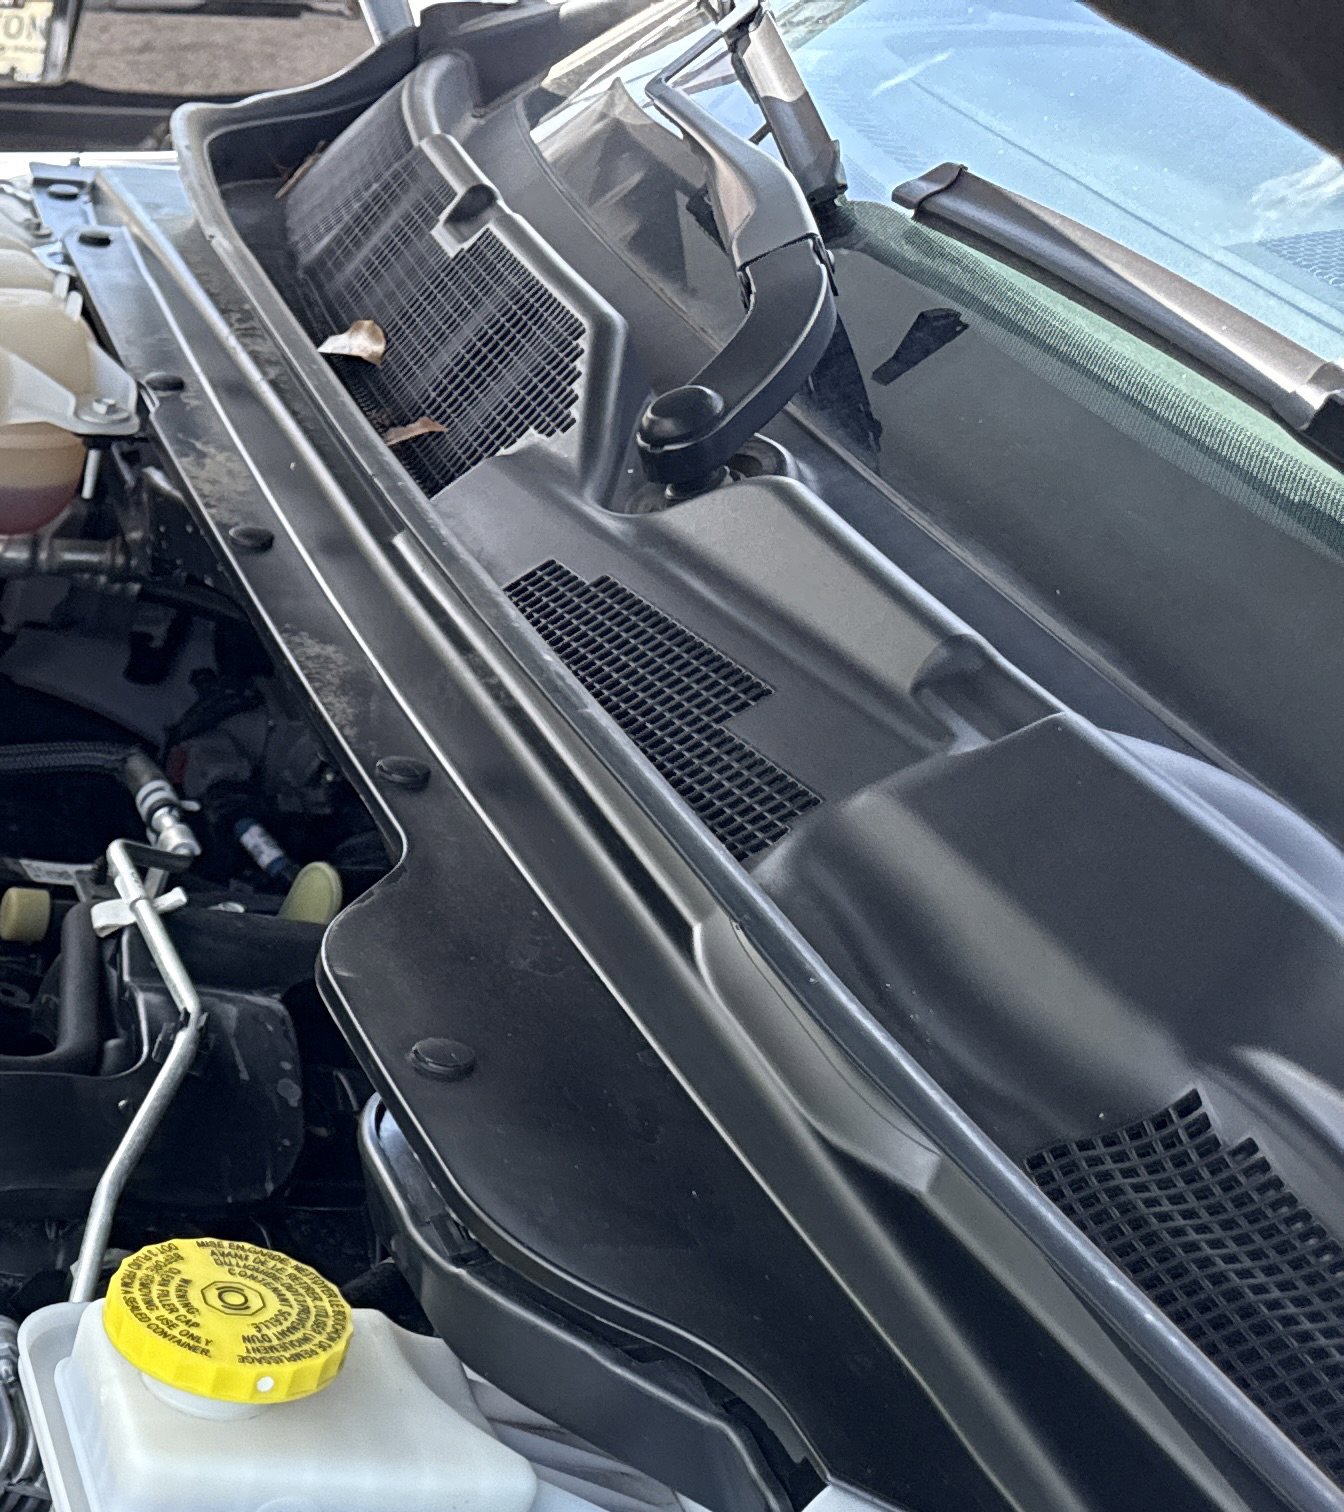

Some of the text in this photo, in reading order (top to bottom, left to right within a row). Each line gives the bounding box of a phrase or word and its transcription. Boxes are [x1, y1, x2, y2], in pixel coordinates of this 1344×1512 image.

[157, 1242, 179, 1255] DOT
[196, 1240, 224, 1249] MISE
[120, 1269, 137, 1289] FROM
[122, 1295, 151, 1323] SEALED
[156, 1288, 179, 1314] FILLER
[174, 1314, 200, 1328] CAP
[154, 1314, 179, 1330] USE
[178, 1329, 213, 1347] ONLY
